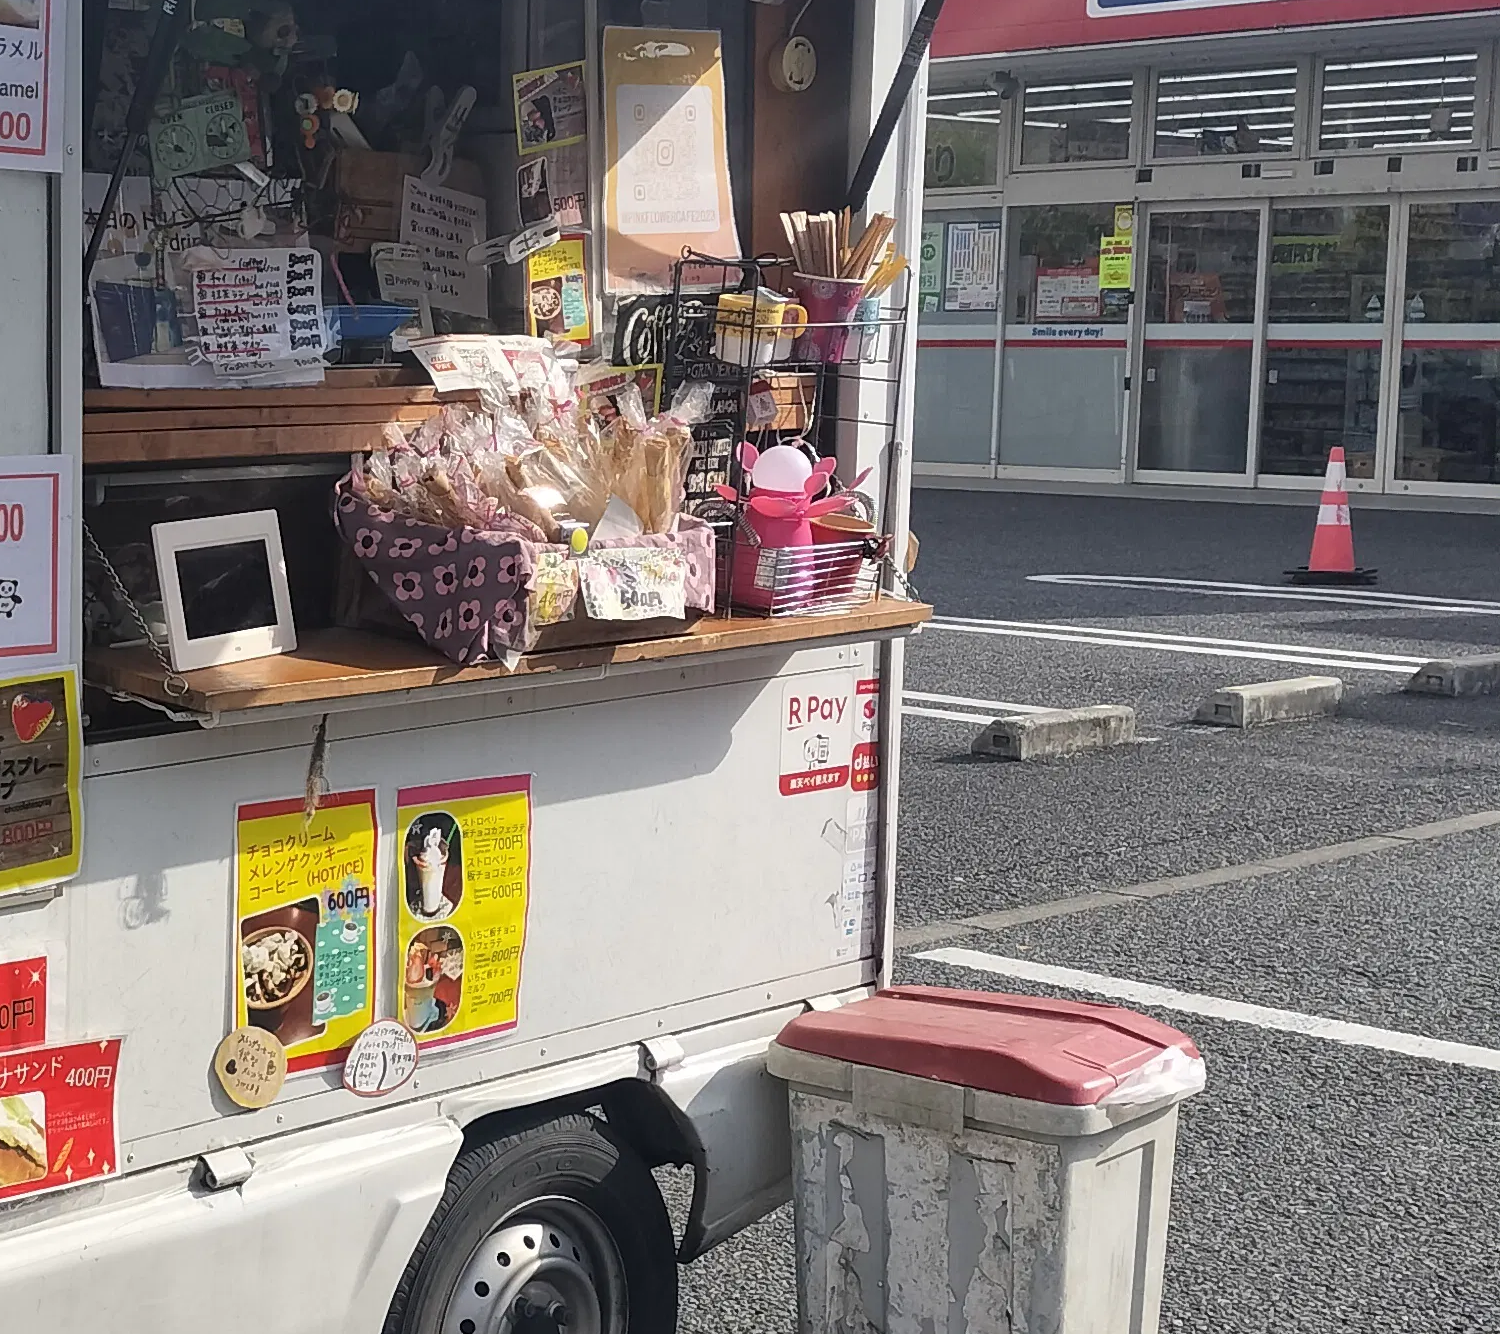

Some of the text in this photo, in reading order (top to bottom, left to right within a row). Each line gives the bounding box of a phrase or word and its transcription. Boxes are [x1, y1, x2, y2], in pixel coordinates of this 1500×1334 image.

[1032, 328, 1103, 338] Smile every day!
[808, 696, 848, 724] Pay
[462, 816, 504, 827] ストロベリー
[247, 826, 335, 861] チョコクリーム
[491, 834, 523, 851] 700円
[249, 846, 348, 882] メレンゲクッキー
[467, 854, 516, 867] ストロベリー
[249, 857, 364, 901] コーヒー (HOT/ICE)
[328, 887, 369, 911] 600円
[492, 882, 522, 899] 600円
[491, 946, 520, 962] 800円
[488, 988, 513, 1005] 700円
[65, 1066, 112, 1088] 400円
